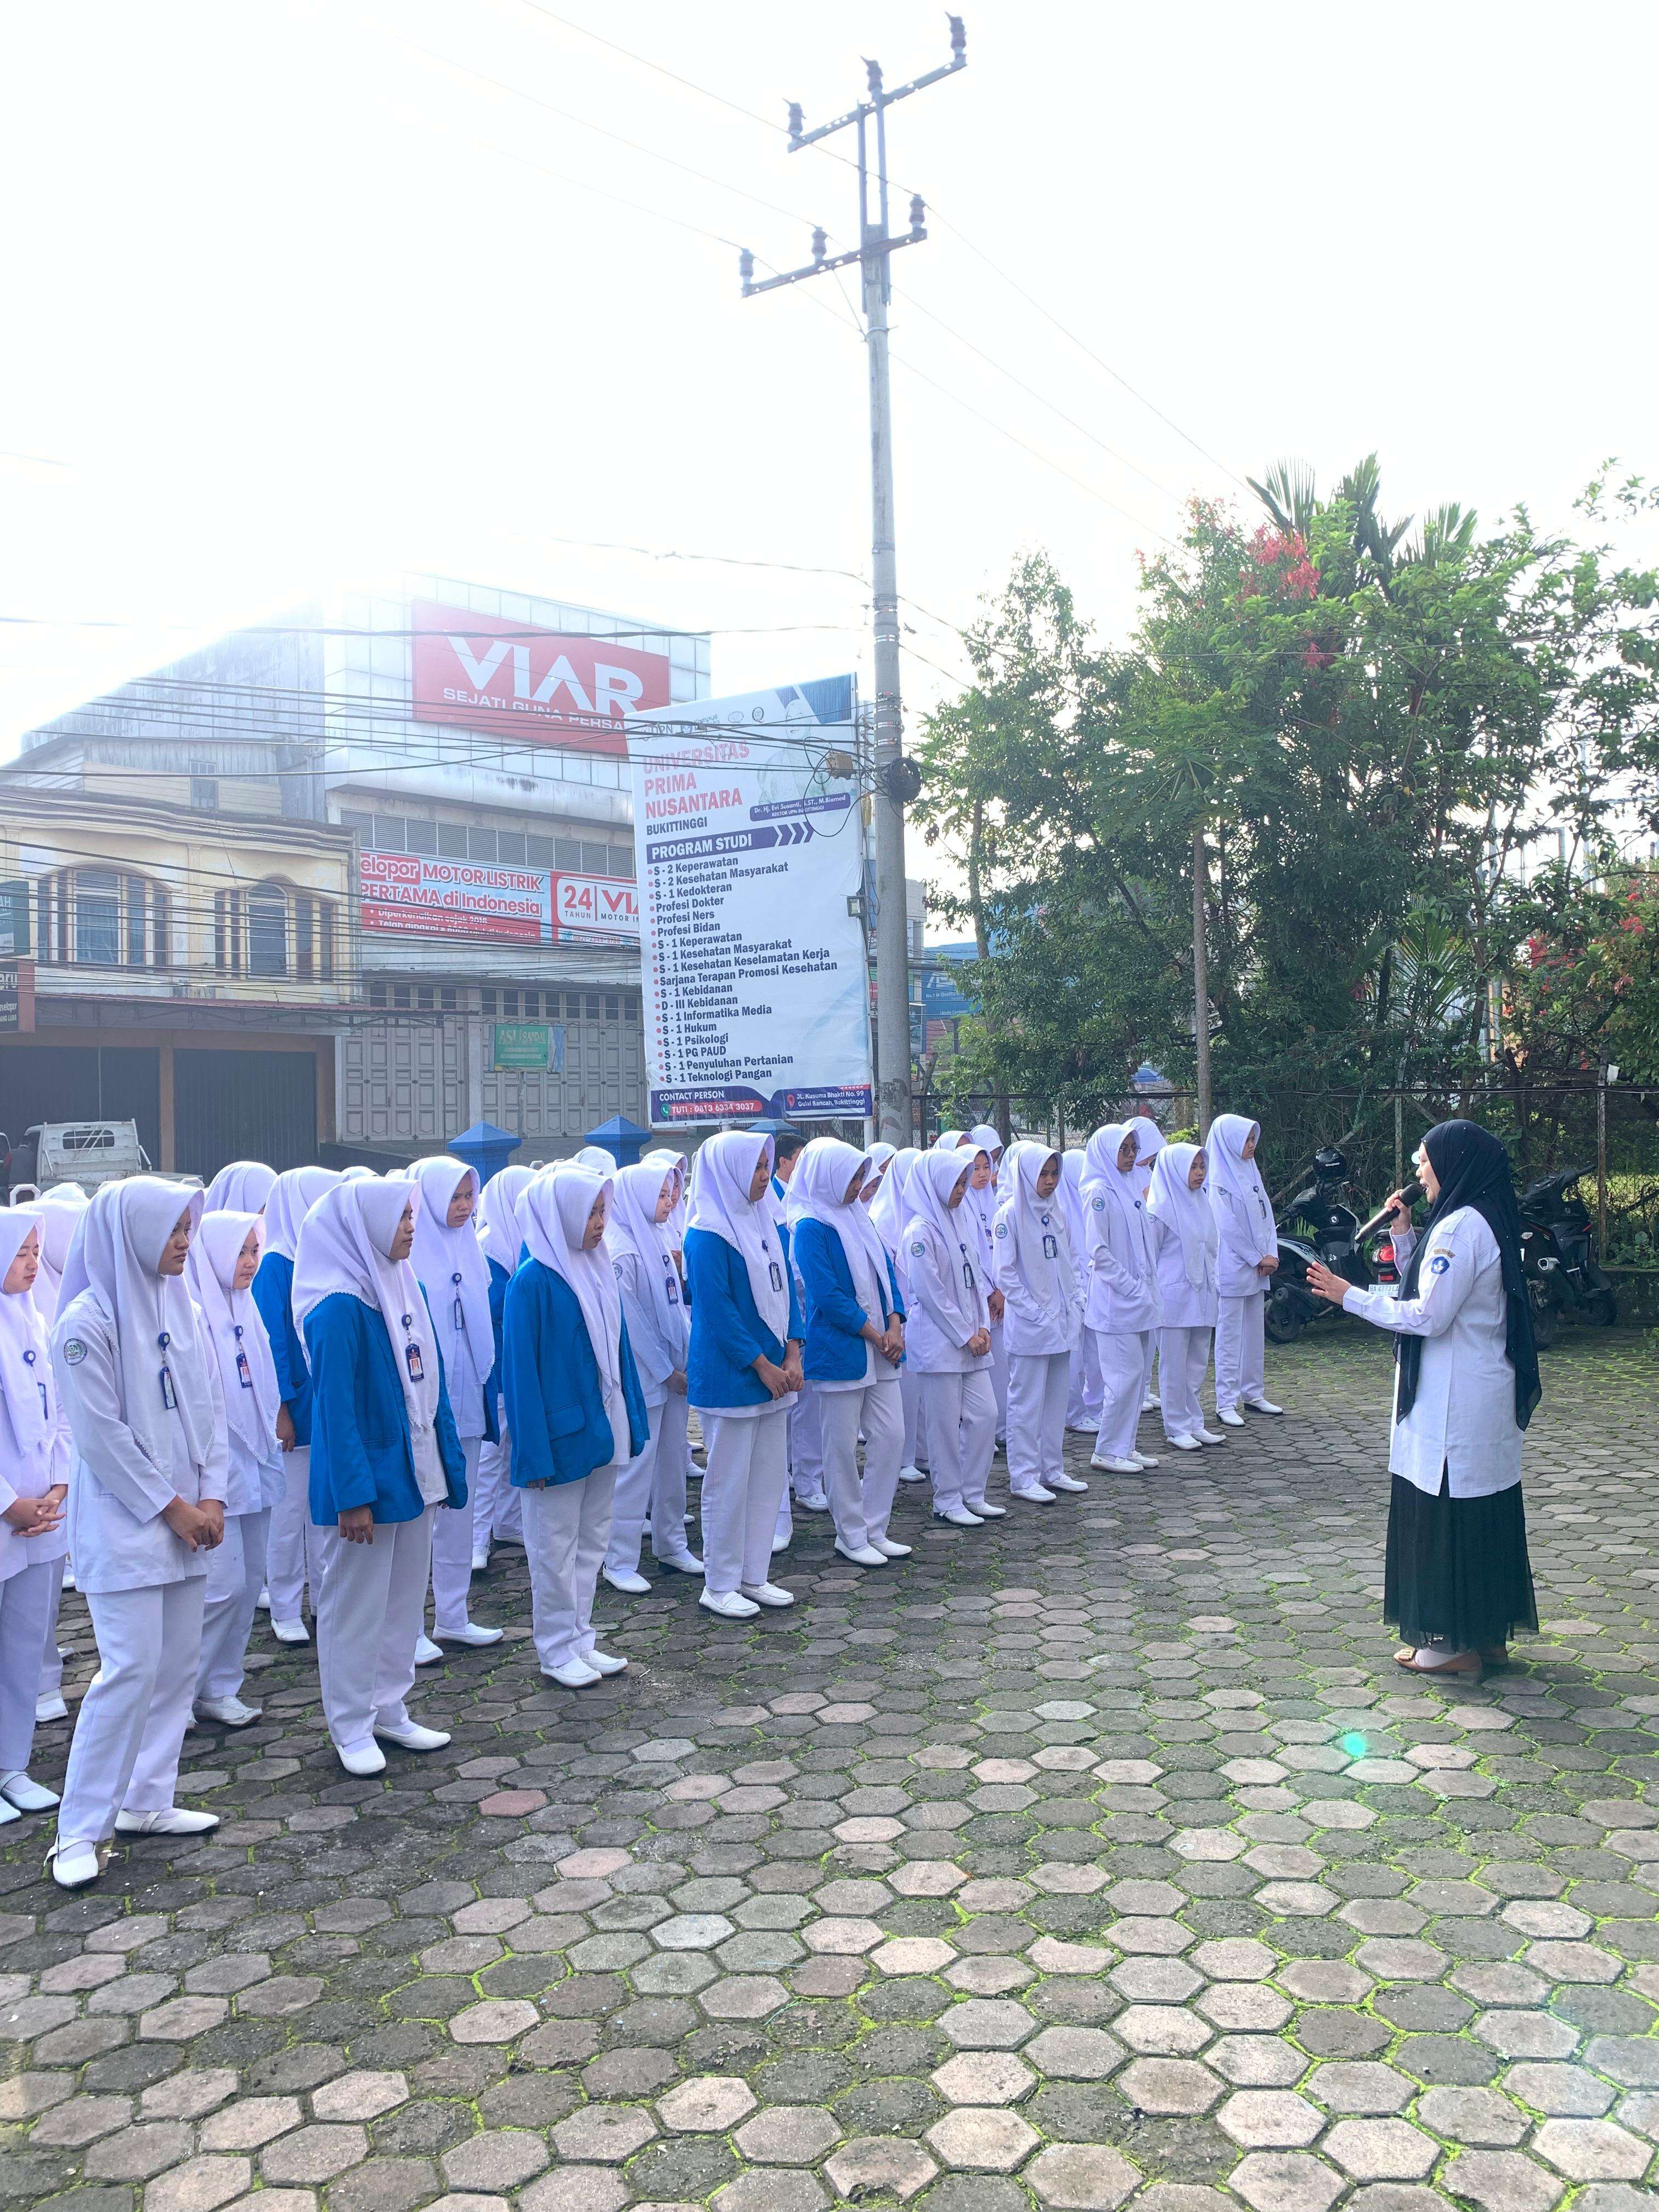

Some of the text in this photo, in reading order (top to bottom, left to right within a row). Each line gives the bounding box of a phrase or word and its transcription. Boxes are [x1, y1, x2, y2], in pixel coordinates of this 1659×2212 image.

[442, 630, 643, 715] VIAR
[443, 687, 505, 708] SEJATI
[513, 701, 562, 720] GUNA
[643, 740, 749, 774] UNIVERSITAS
[644, 772, 697, 797] PRIMA
[645, 788, 743, 819] NUSANTARA
[781, 801, 802, 809] Susanti,
[819, 795, 846, 804] M.Biomed
[646, 816, 708, 836] BUKITTINGGI
[652, 834, 752, 860] PROGRAM STUDI
[653, 866, 660, 876] S
[667, 864, 673, 874] 2
[675, 857, 738, 873] Keperawatan
[654, 878, 661, 888] S
[668, 877, 674, 887] 2
[676, 871, 727, 885] Kesehatan
[730, 861, 789, 878] Masyarakat
[423, 863, 484, 885] MOTOR
[487, 871, 541, 890] LISTRIK
[361, 882, 540, 915] PERTAMA di Indonesia
[564, 885, 592, 911] 24
[655, 890, 662, 901] S
[669, 889, 675, 899] 1
[676, 883, 732, 898] Kedokteran
[656, 896, 724, 913] Profesi Dokter
[565, 911, 591, 919] TAHUN
[657, 910, 715, 925] Profesi Ners
[657, 922, 720, 938] Profesi Bidan
[658, 940, 664, 950] S
[672, 938, 678, 948] 1
[679, 932, 742, 948] Keperawatan
[658, 952, 665, 962] S
[672, 950, 679, 961] 1
[680, 946, 731, 960] Kesehatan
[733, 938, 792, 954] Masyarakat
[659, 964, 666, 974] S
[673, 962, 679, 973] 1
[681, 958, 732, 972] Kesehatan
[734, 952, 800, 967] Keselamatan
[802, 947, 830, 961] Kerja
[659, 961, 838, 987] Sarjana Terapan Promosi Kesehatan
[661, 989, 667, 998] S
[674, 987, 680, 997] 1
[682, 984, 733, 996] Kebidanan
[661, 1001, 668, 1011] D
[675, 999, 685, 1009] III
[687, 996, 738, 1008] Kebidanan
[662, 1013, 668, 1023] S
[675, 1012, 682, 1022] 1
[684, 1007, 740, 1021] Informatika
[742, 1004, 772, 1016] Media
[662, 1025, 669, 1035] S
[676, 1024, 682, 1034] 1
[684, 1022, 717, 1033] Hukum
[663, 1037, 670, 1047] S
[676, 1036, 683, 1046] 1
[685, 1032, 729, 1046] Psikologi
[664, 1049, 671, 1059] S
[678, 1048, 684, 1058] 1
[685, 1047, 699, 1058] PG
[701, 1046, 726, 1057] PAUD
[664, 1062, 672, 1071] S
[679, 1060, 685, 1070] 1
[686, 1058, 742, 1071] Penyuluhan
[744, 1054, 793, 1066] Pertanian
[665, 1074, 673, 1084] S
[679, 1073, 686, 1082] 1
[687, 1069, 733, 1082] Teknologi
[735, 1069, 772, 1080] Pangan
[659, 1090, 725, 1102] CONTACT PERSON
[694, 1104, 713, 1113] 0813
